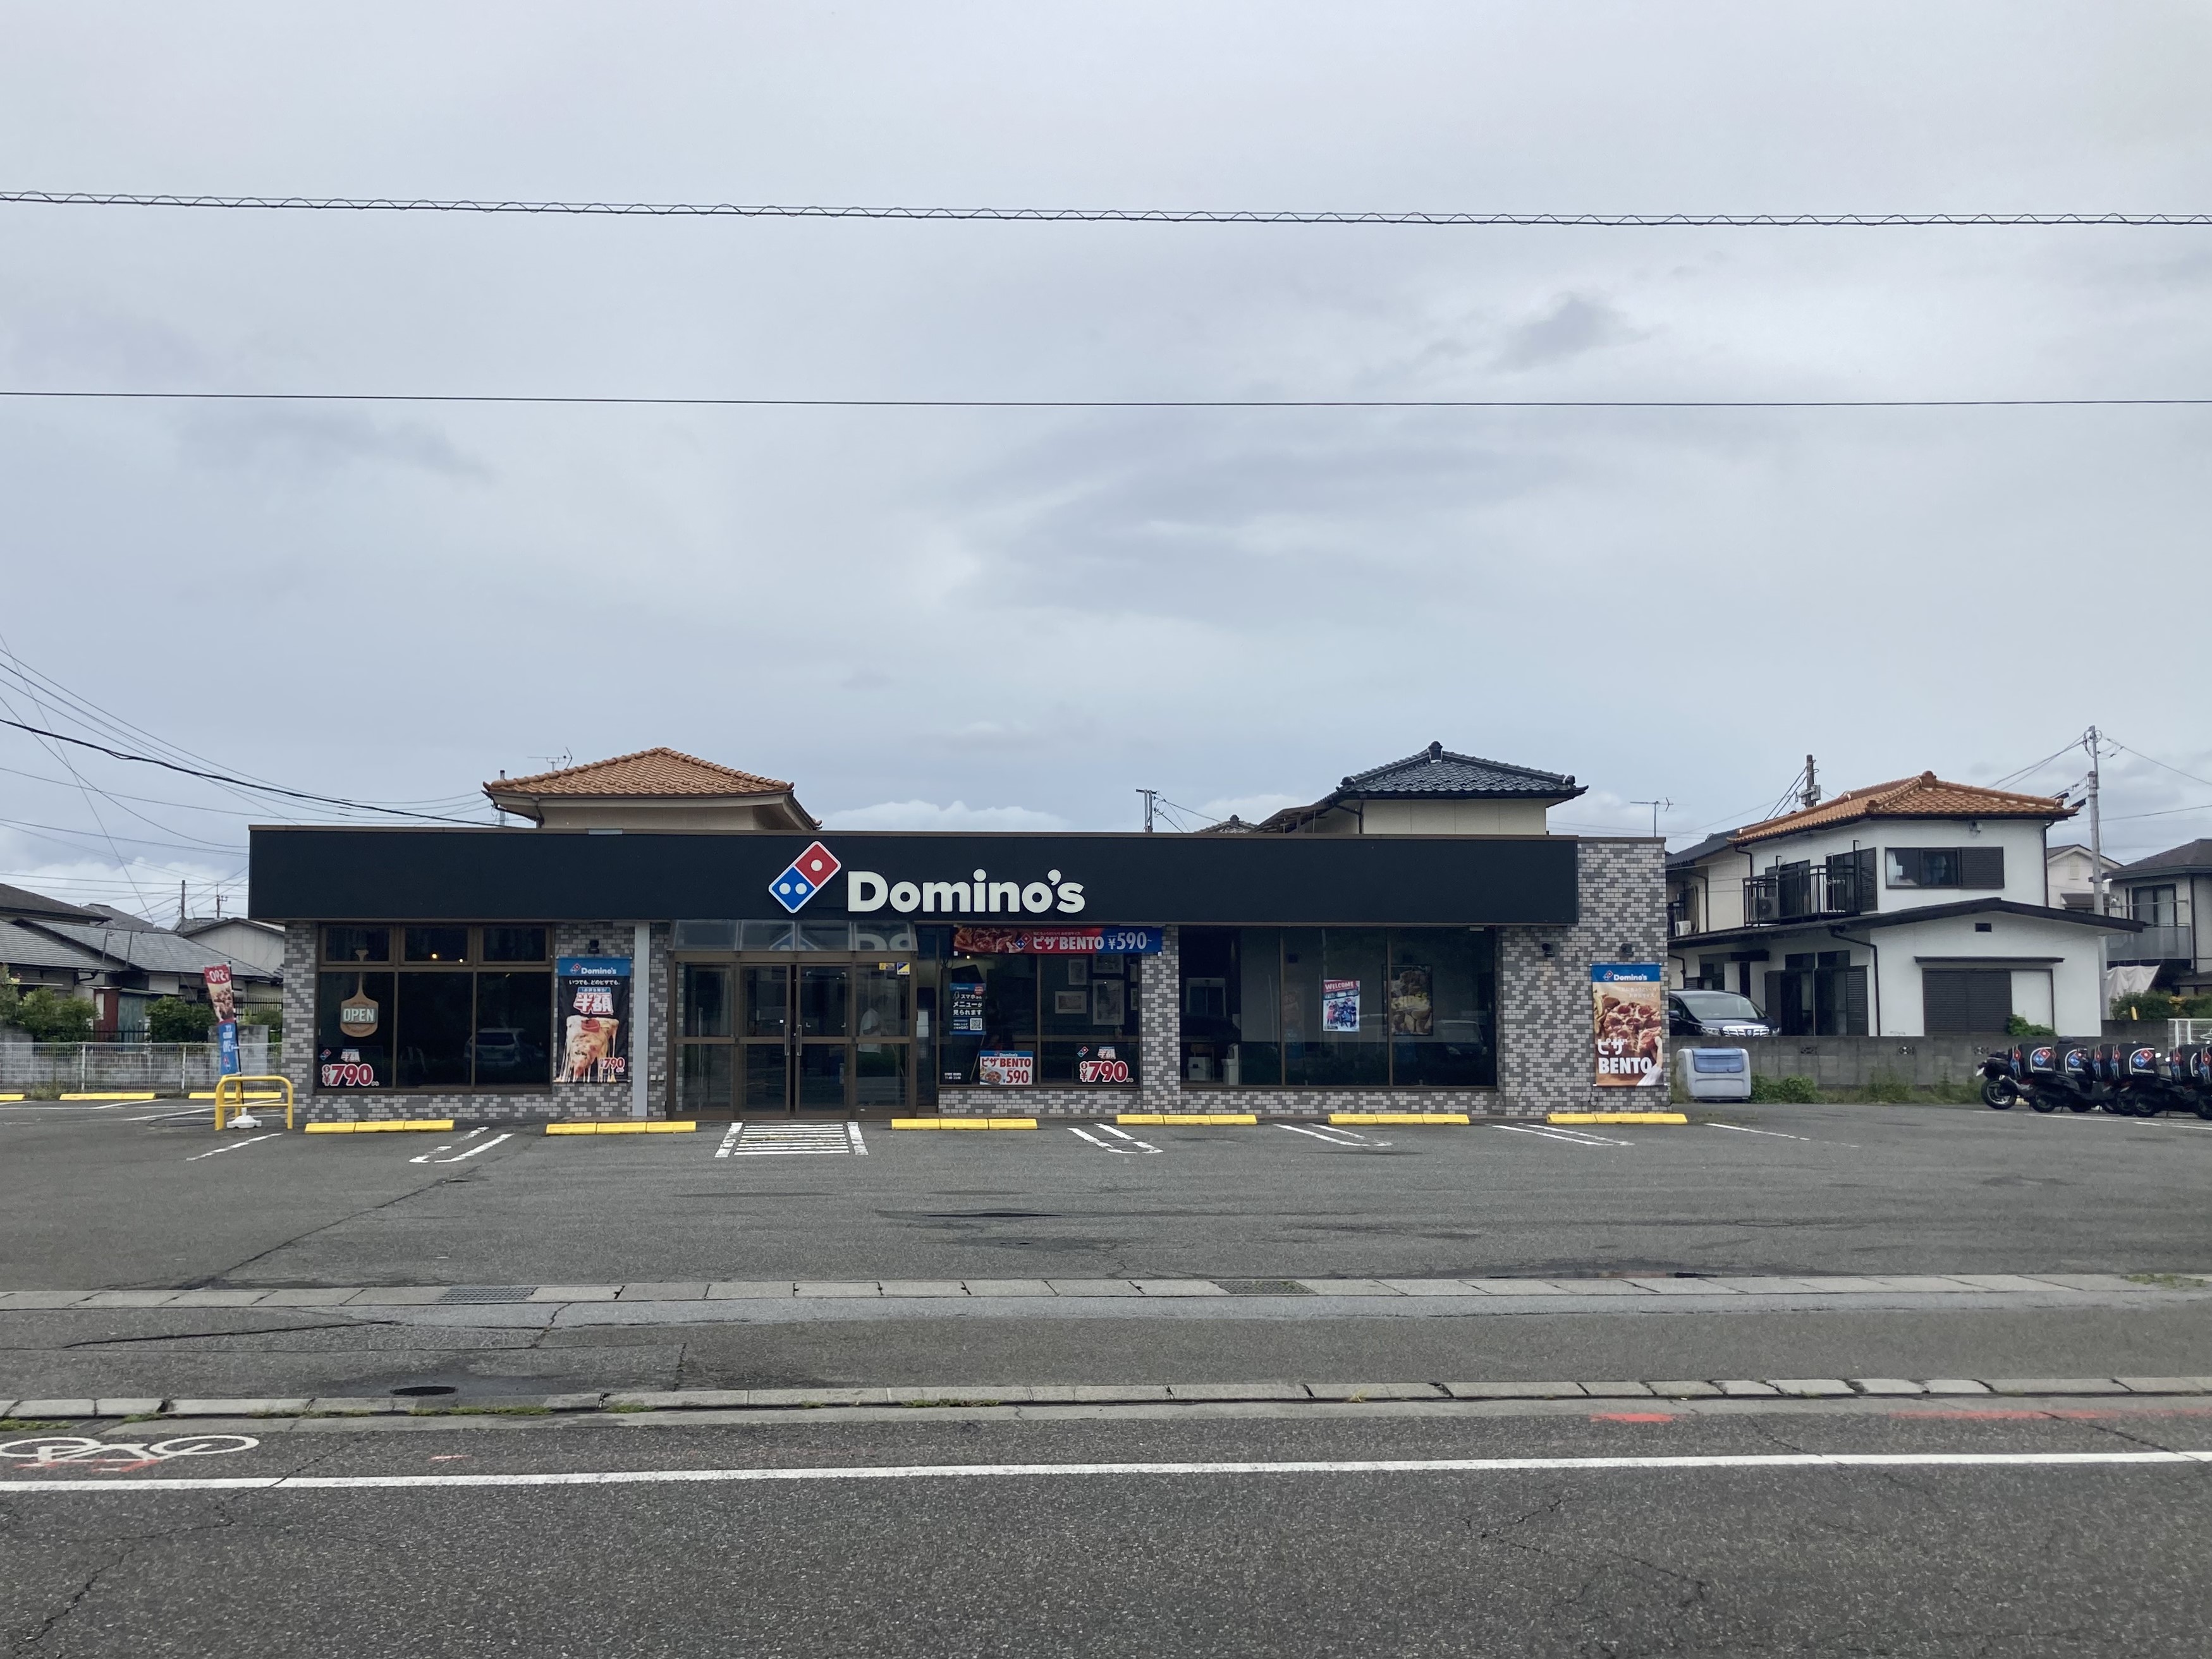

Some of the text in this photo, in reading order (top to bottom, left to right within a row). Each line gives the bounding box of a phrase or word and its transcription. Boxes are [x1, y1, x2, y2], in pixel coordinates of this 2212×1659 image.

[848, 868, 1085, 913] Domino's
[1325, 981, 1353, 990] WELCOME
[575, 993, 612, 1012] 半額
[343, 1008, 374, 1022] OPEN
[1598, 1039, 1628, 1055] ピザ
[1598, 1057, 1652, 1074] BENTO
